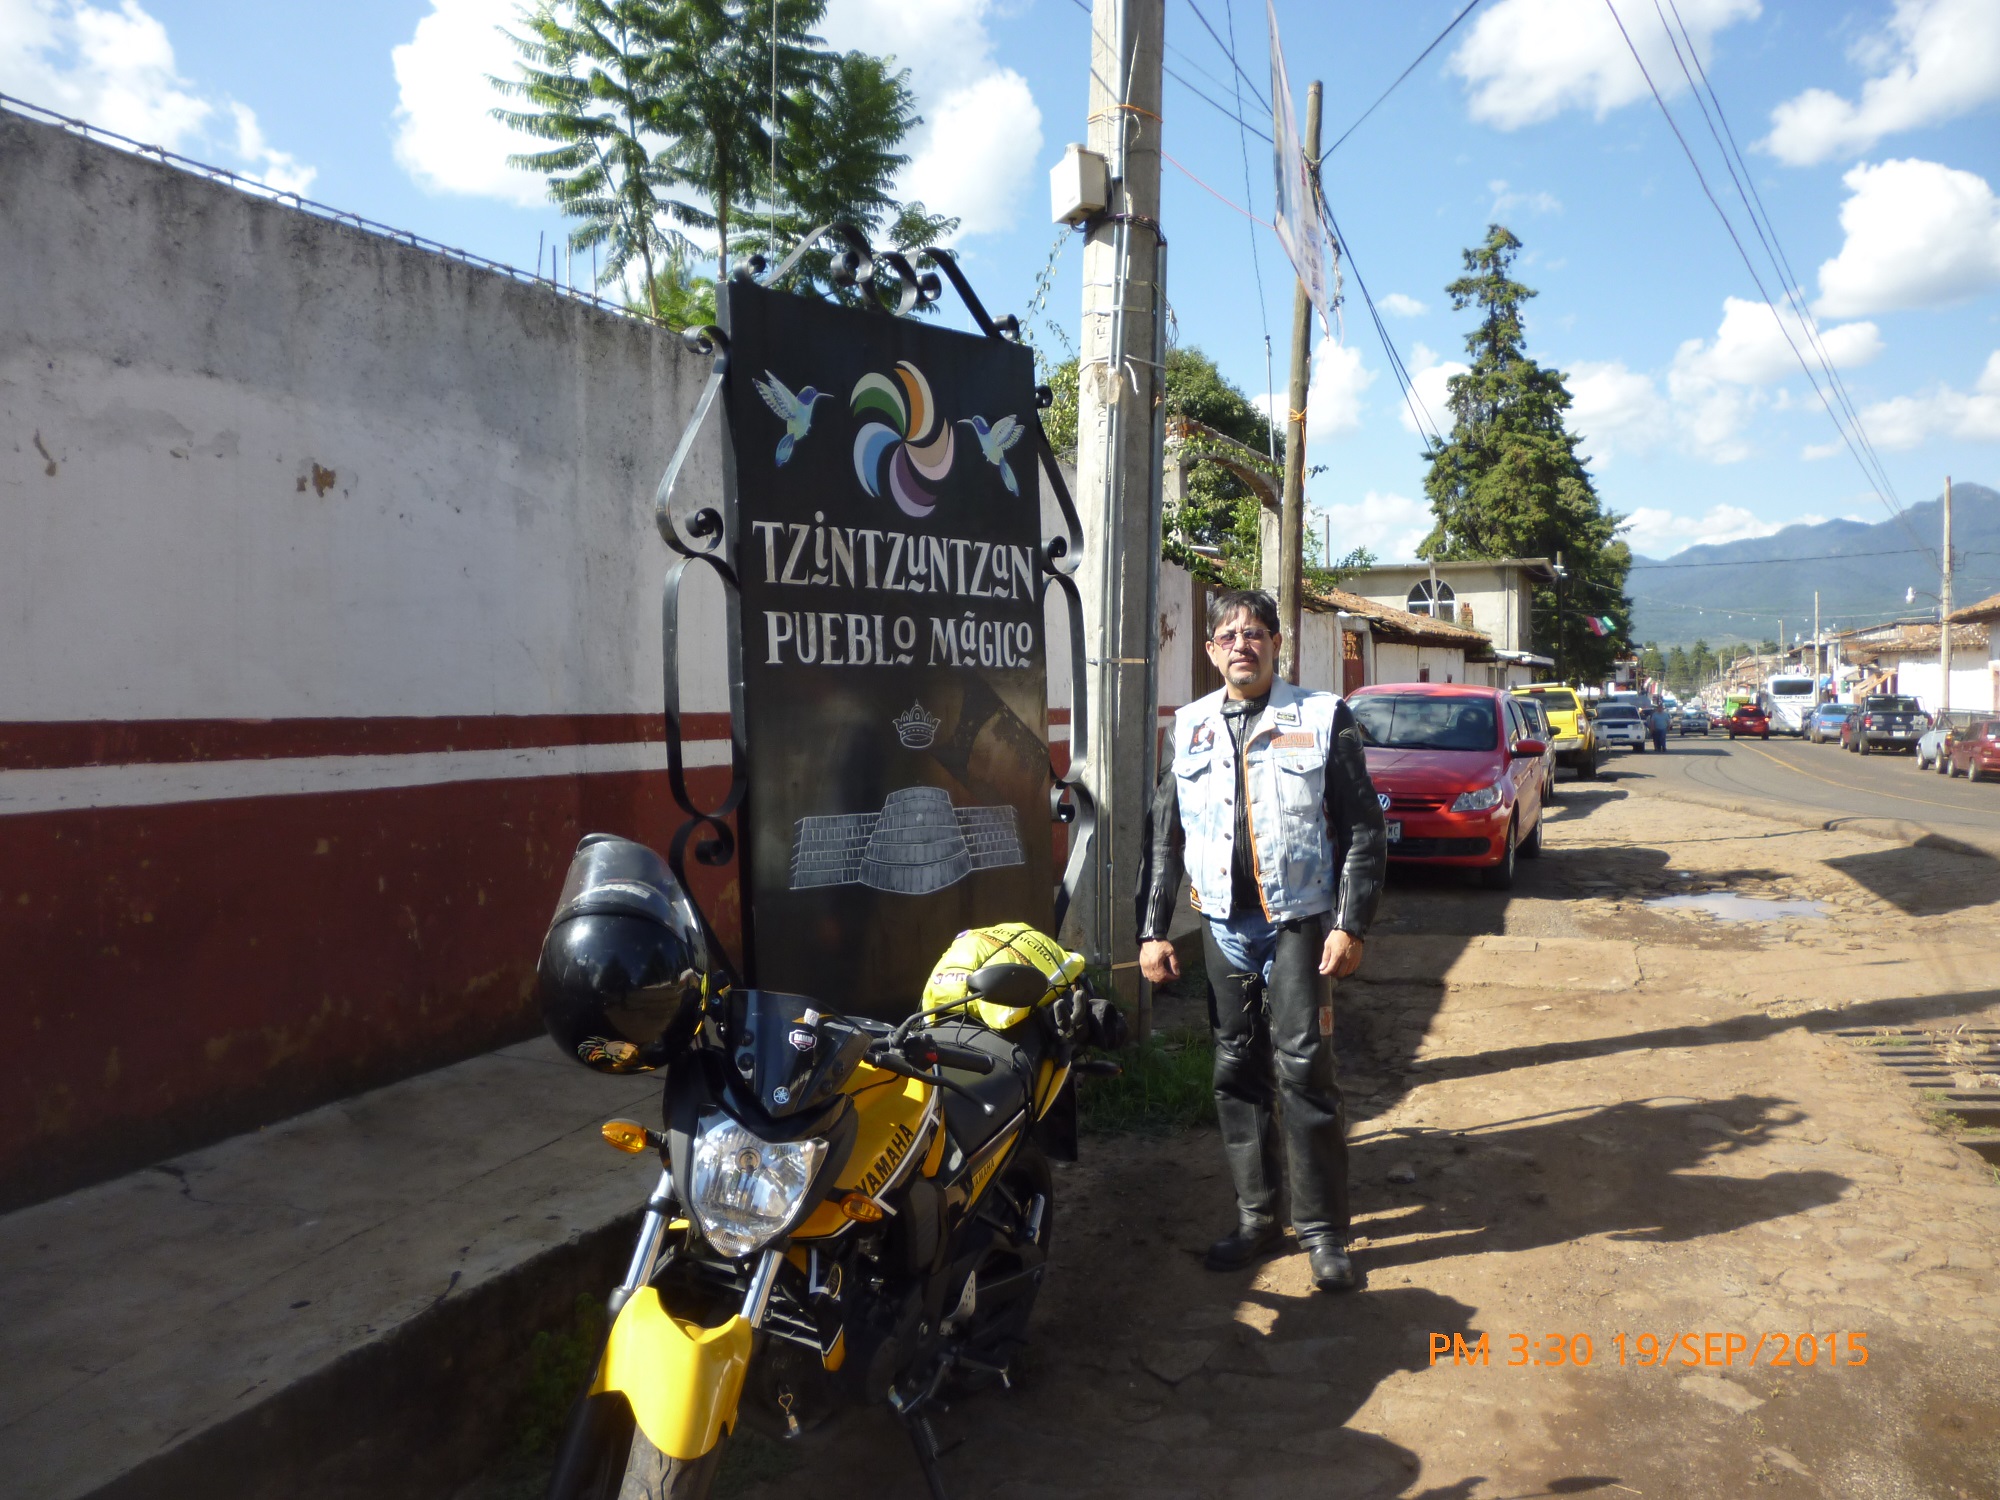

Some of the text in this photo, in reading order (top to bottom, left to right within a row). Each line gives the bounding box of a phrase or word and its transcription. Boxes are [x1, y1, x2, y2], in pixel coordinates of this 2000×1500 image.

[752, 510, 1034, 602] TZiNTZuNTZaN
[762, 610, 916, 666] PUEBLO
[855, 1123, 915, 1197] YAMAHA
